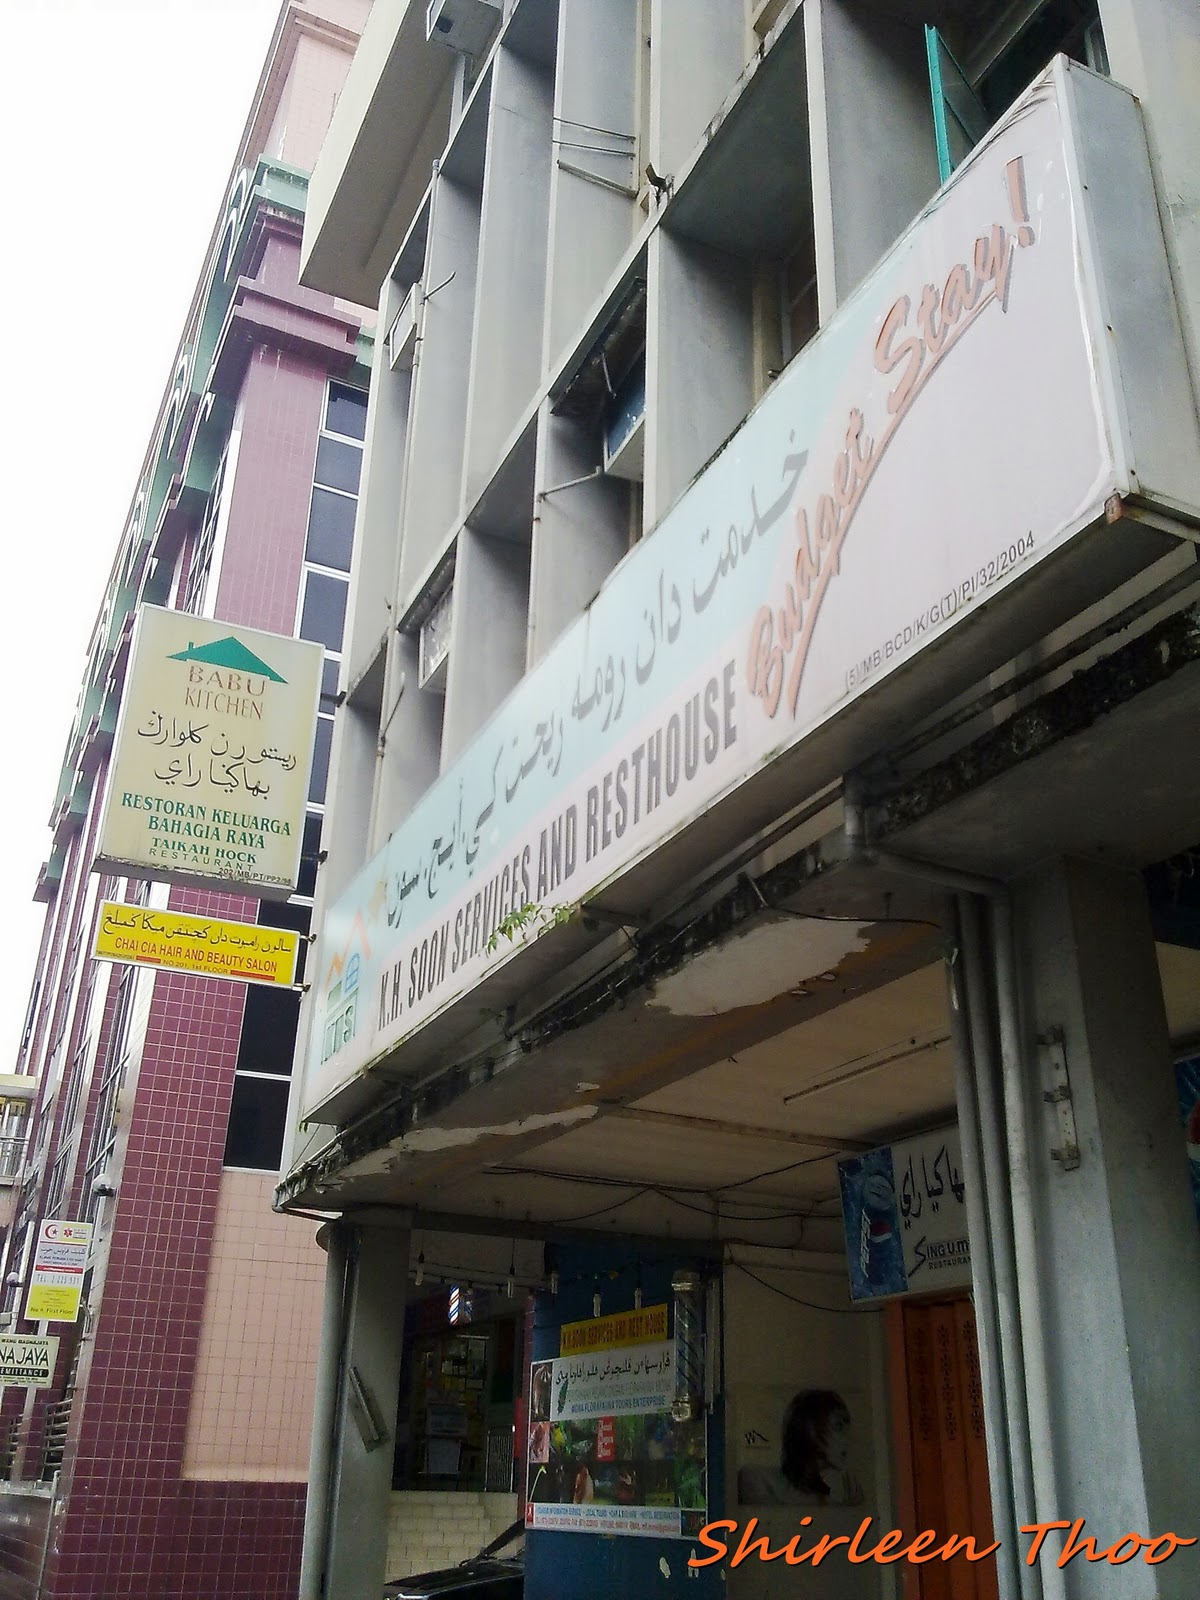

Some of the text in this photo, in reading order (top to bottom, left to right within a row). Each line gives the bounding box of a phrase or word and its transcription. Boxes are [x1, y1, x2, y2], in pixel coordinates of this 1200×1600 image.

[746, 156, 1036, 719] Budget Stay!
[636, 568, 682, 685] دان
[188, 665, 266, 697] BABU
[184, 687, 264, 720] KITCHEN
[154, 753, 202, 787] راي
[121, 793, 291, 836] RESTORAN KELUARGA
[148, 815, 266, 849] BAHAGIA RAYA
[378, 659, 738, 1032] K.H. SOON SERVICES AND RESTHOUSE
[149, 848, 253, 872] RESTAURANT
[152, 837, 257, 864] TAIKAH HOCK
[115, 937, 278, 973] CHAI CIA HAIR AND BEAUTY SALON
[928, 1256, 971, 1270] RESTAURA
